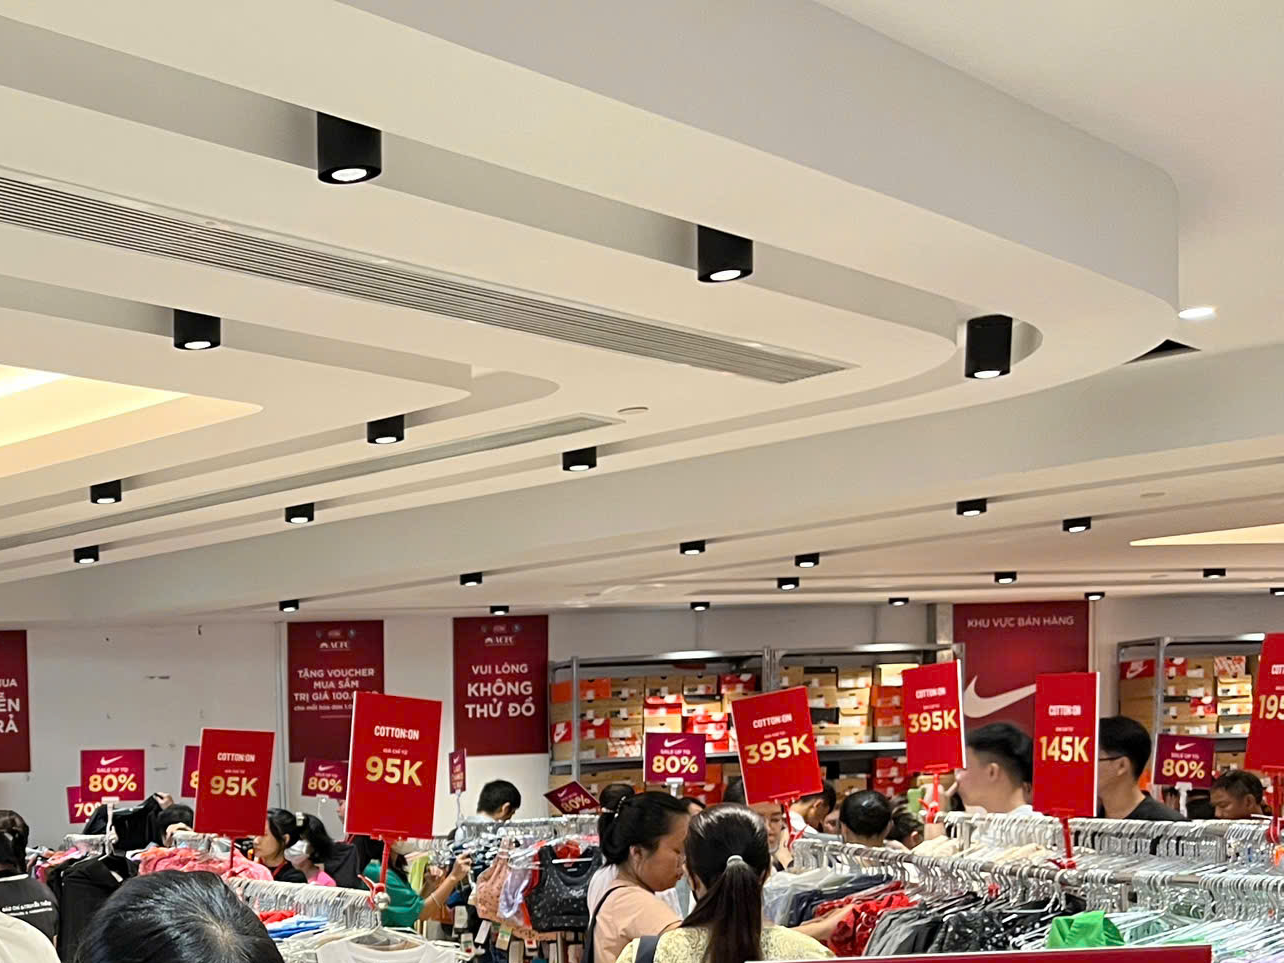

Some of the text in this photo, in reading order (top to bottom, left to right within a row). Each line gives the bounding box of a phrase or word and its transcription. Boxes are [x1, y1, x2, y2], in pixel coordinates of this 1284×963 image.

[967, 619, 990, 628] KHU
[1017, 615, 1040, 627] BÁN
[1043, 615, 1074, 625] HÀNG
[297, 667, 375, 680] TẶNG VOUCHER
[471, 661, 528, 675] VUI LÒNG
[313, 677, 359, 689] MUA SẮM
[467, 678, 532, 697] KHÔNG
[293, 692, 309, 702] TRỊ
[311, 690, 329, 701] GIÁ
[464, 696, 535, 718] THỬ ĐỒ
[1259, 695, 1284, 720] 195
[907, 709, 957, 733] 395K
[374, 725, 420, 740] COTTON:ON
[217, 752, 256, 762] COTTON:ON
[744, 734, 811, 764] 395K
[1039, 736, 1090, 762] 145K
[366, 755, 423, 786] 95K
[652, 755, 698, 774] 80%
[1162, 759, 1205, 779] 80%
[88, 773, 137, 792] 80%
[210, 775, 258, 797] 95K
[308, 776, 343, 793] 80%
[561, 794, 591, 812] 80%
